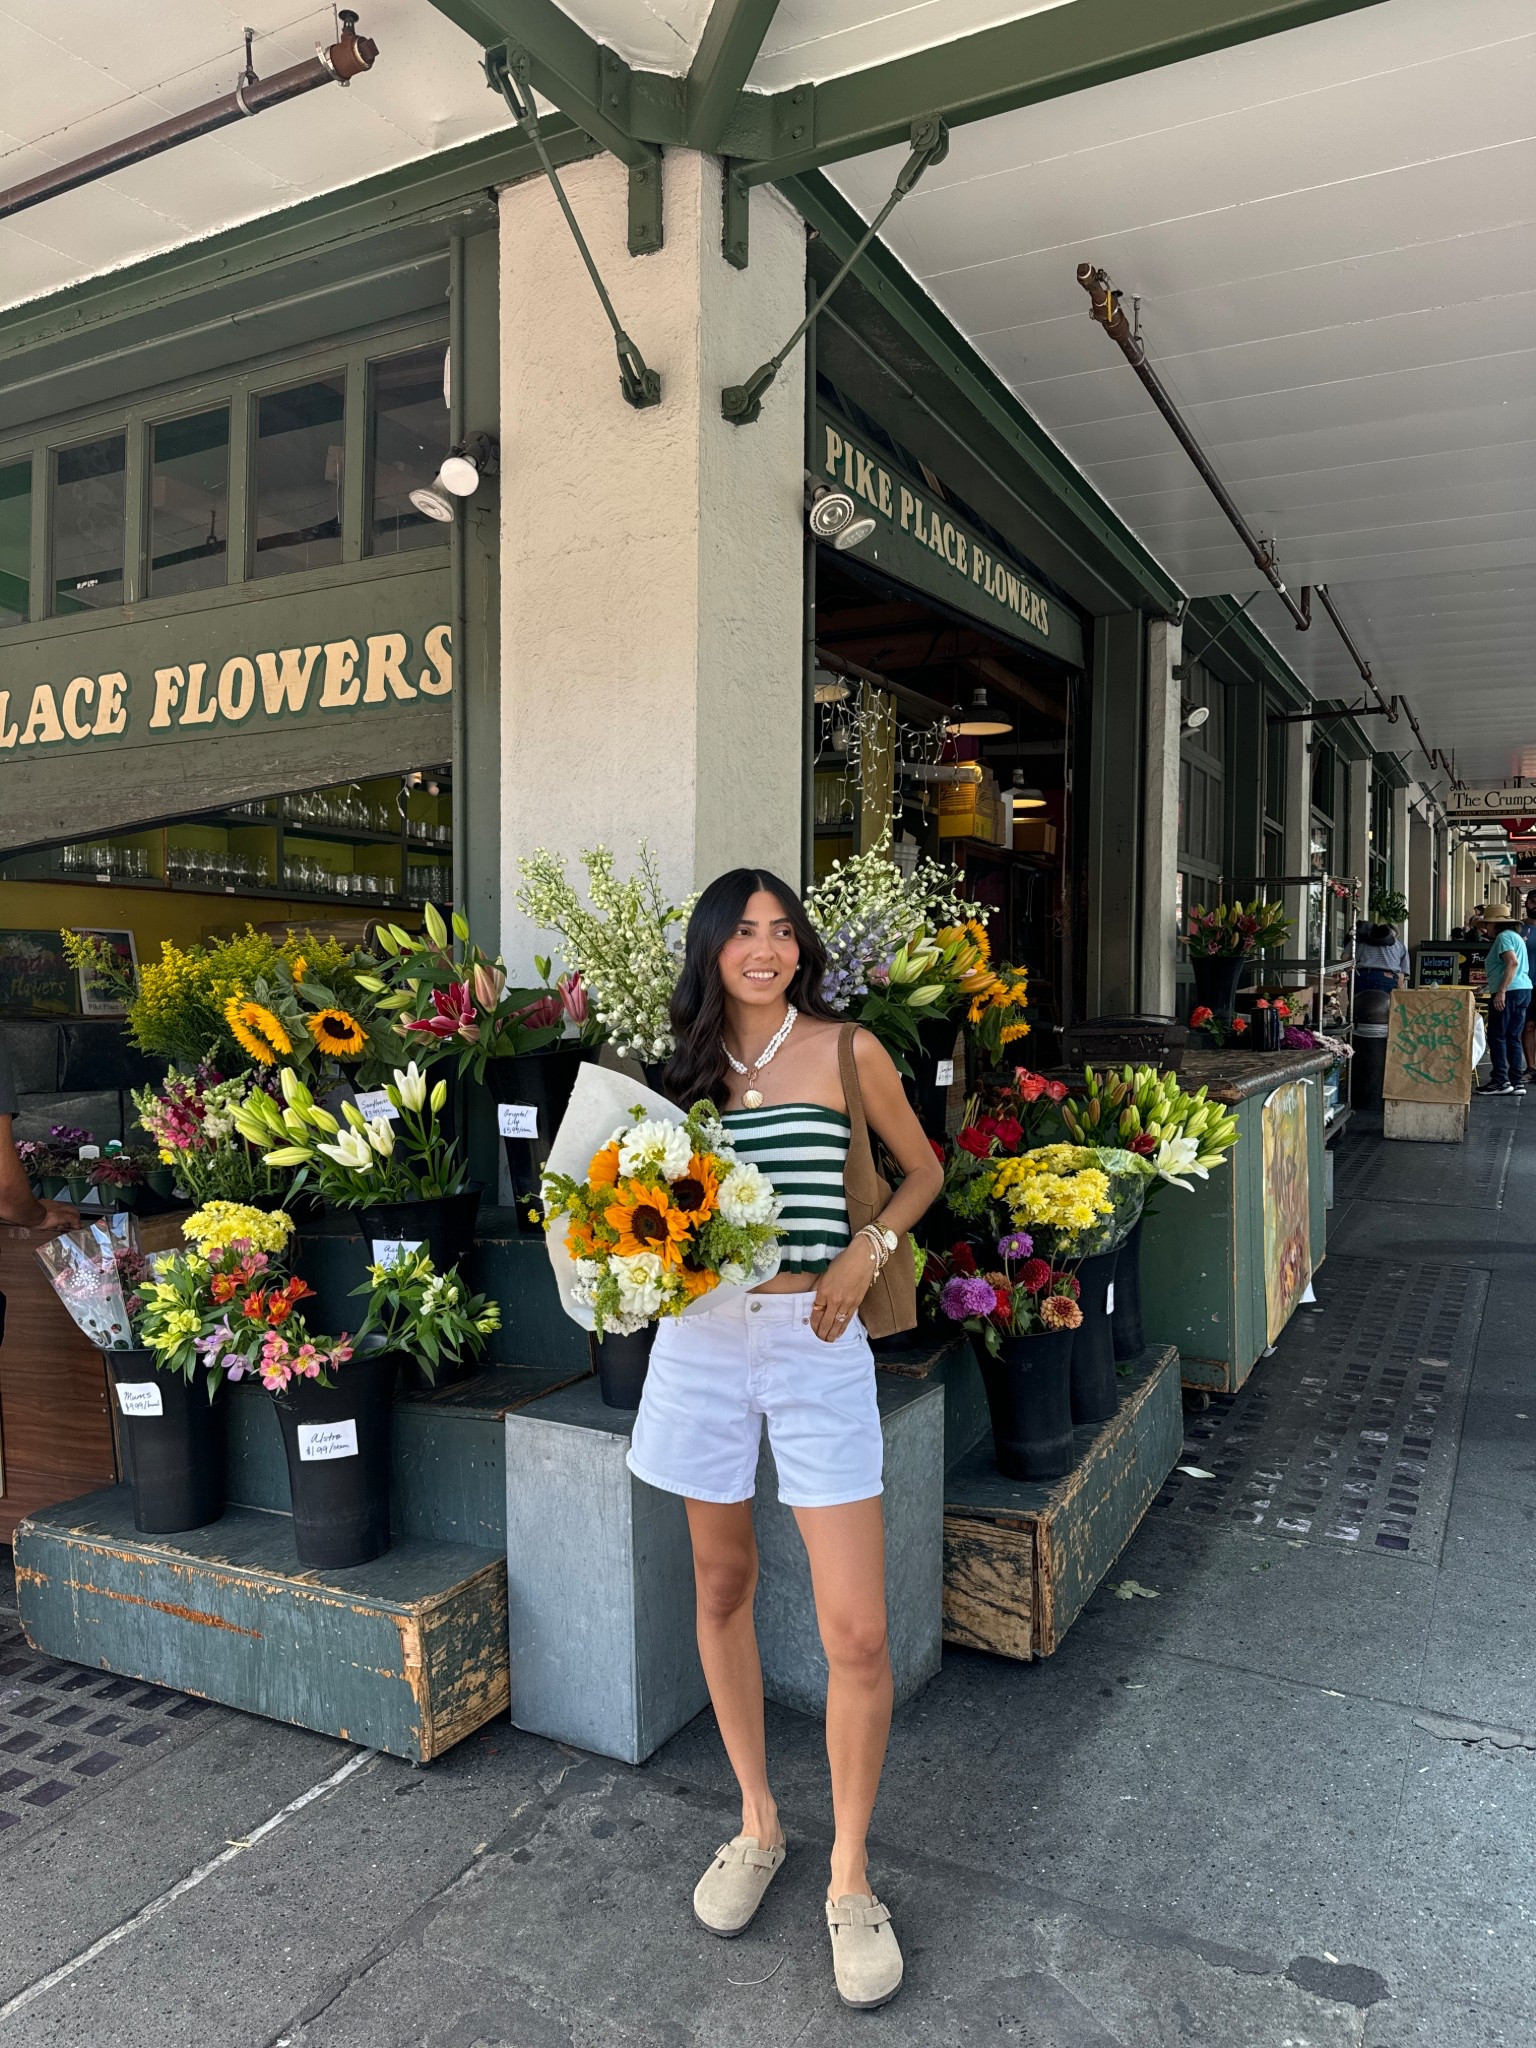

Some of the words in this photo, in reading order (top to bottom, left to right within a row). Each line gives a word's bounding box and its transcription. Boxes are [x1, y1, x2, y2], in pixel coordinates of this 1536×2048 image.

[825, 425, 893, 519] PIKE
[900, 485, 968, 576] PLACE
[972, 544, 1049, 636] FLOWERS
[149, 625, 452, 728] FLOWERS
[1454, 792, 1481, 809] The
[1393, 1030, 1462, 1061] Sale
